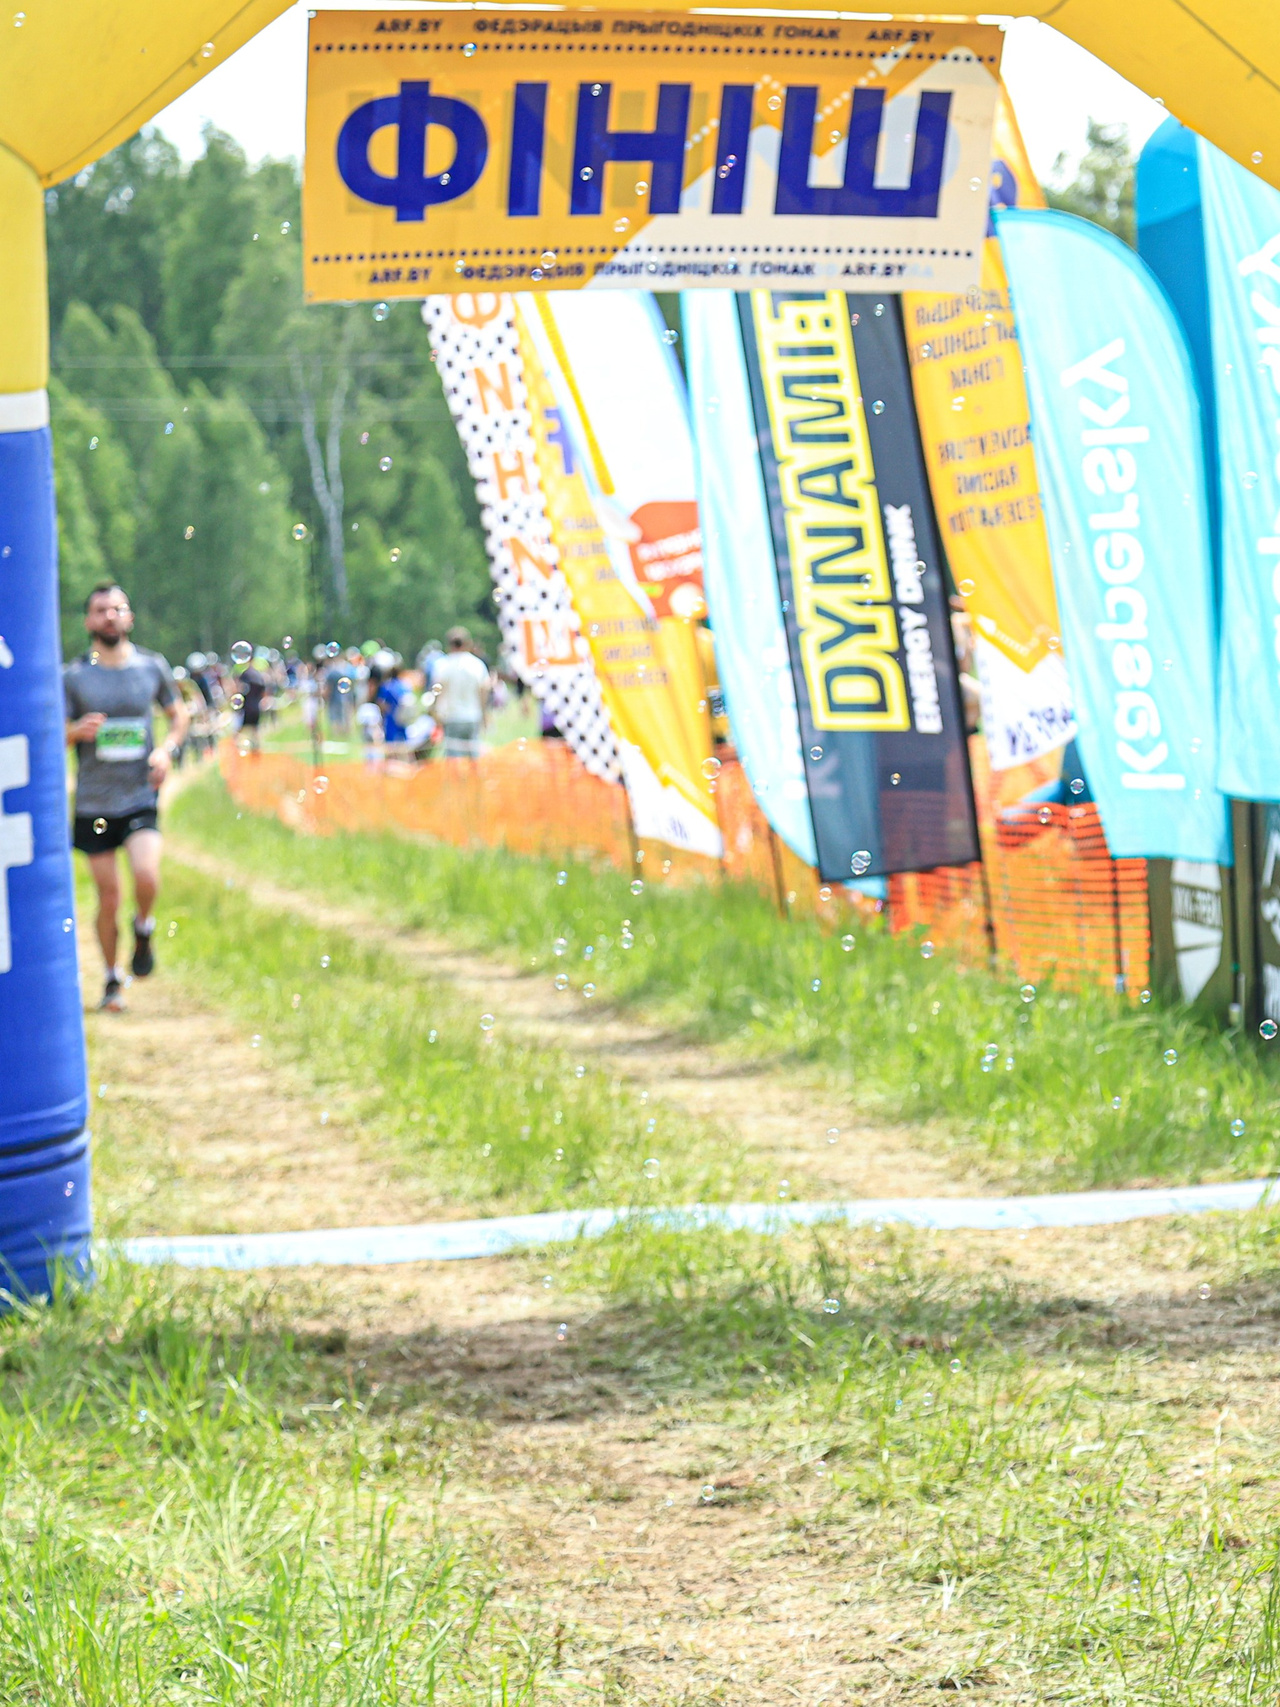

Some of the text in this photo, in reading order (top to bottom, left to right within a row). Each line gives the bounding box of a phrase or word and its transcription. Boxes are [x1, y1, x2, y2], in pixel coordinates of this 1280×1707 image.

[335, 78, 953, 222] ФІНІШ
[884, 503, 942, 733] ENERGY DRINK
